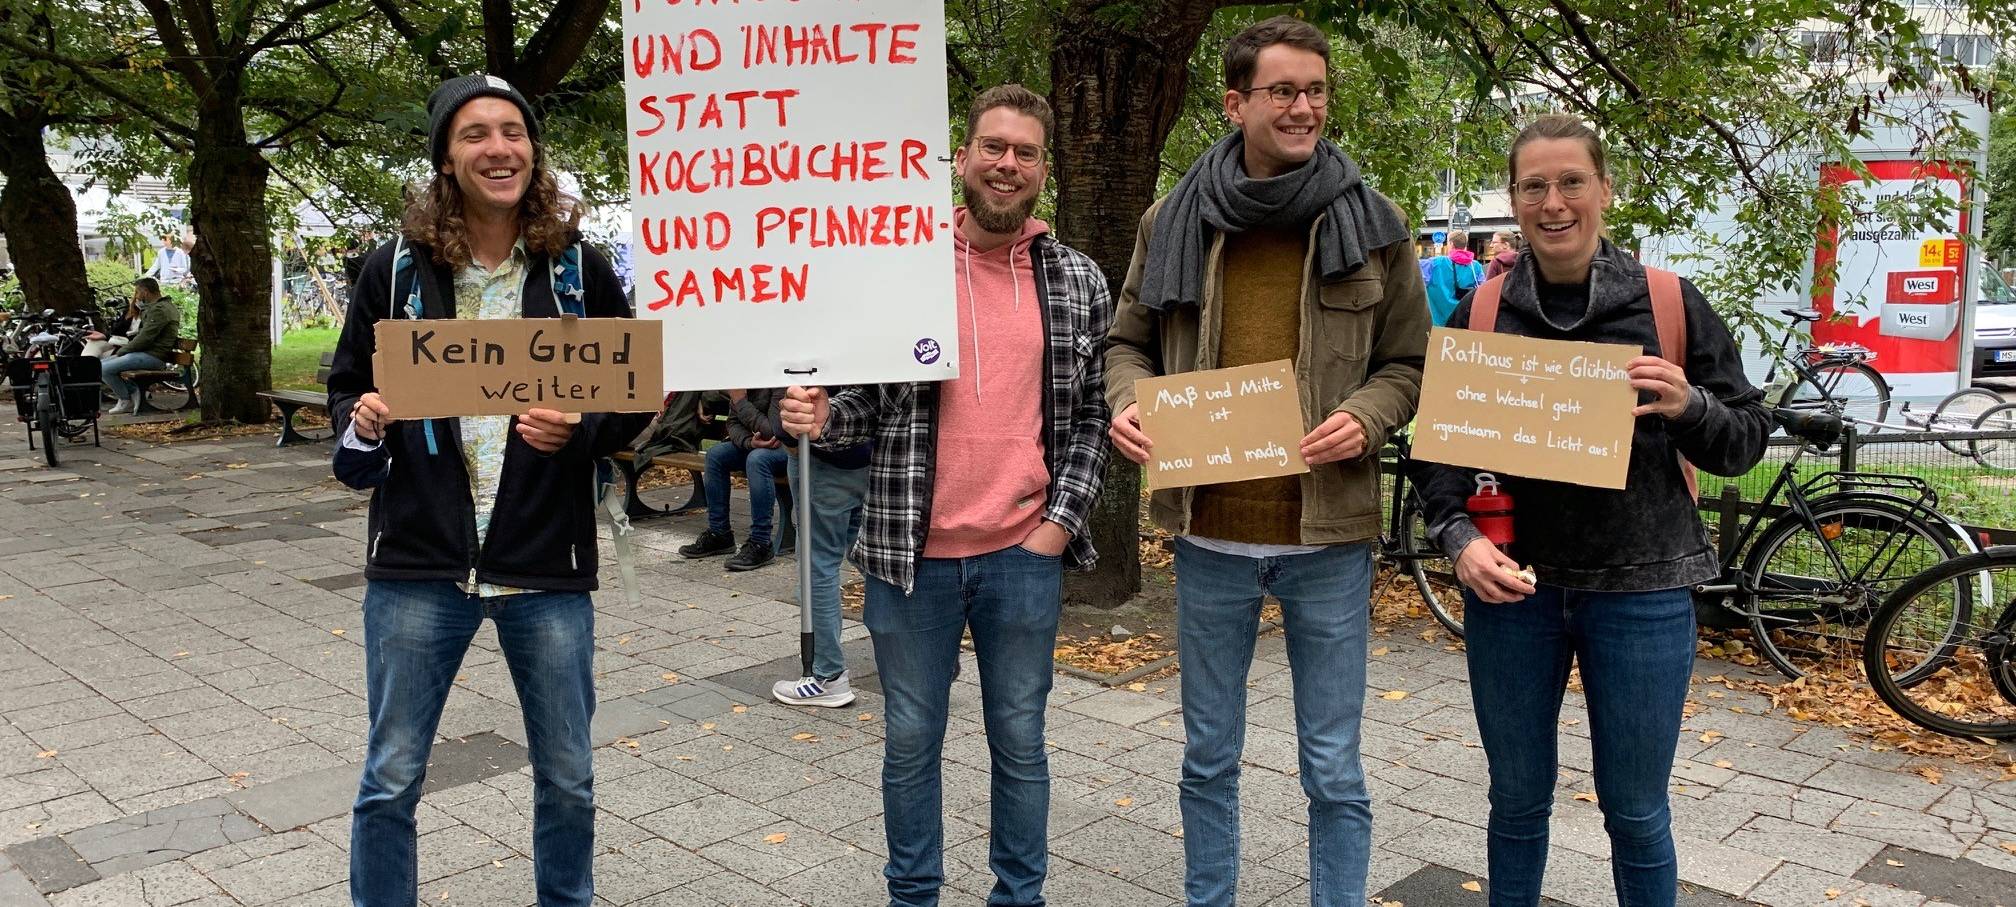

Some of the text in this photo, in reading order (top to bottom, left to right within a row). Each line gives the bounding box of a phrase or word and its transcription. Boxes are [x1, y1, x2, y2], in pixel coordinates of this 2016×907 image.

[632, 23, 920, 78] UND INHALTE
[637, 89, 799, 136] STATT
[640, 139, 930, 195] KOCHBÜCHER
[642, 205, 948, 256] UND PFLANZEN-
[1852, 228, 1919, 243] ausgezalt.
[648, 264, 808, 311] SAMEN
[1907, 280, 1935, 290] West
[1898, 312, 1927, 325] West
[412, 330, 630, 365] Kein Grad
[914, 340, 938, 354] Volt
[1441, 336, 1512, 368] Rathaus
[1522, 355, 1539, 371] ist
[1545, 361, 1562, 375] wie
[481, 376, 600, 402] weiter
[1206, 382, 1232, 400] und
[1456, 385, 1582, 421] ohne Wechsel geht
[1209, 406, 1232, 422] ist
[1433, 421, 1501, 441] irgendwann
[1514, 427, 1536, 444] das
[1547, 431, 1583, 451] Licht
[1159, 441, 1288, 471] mau und madig
